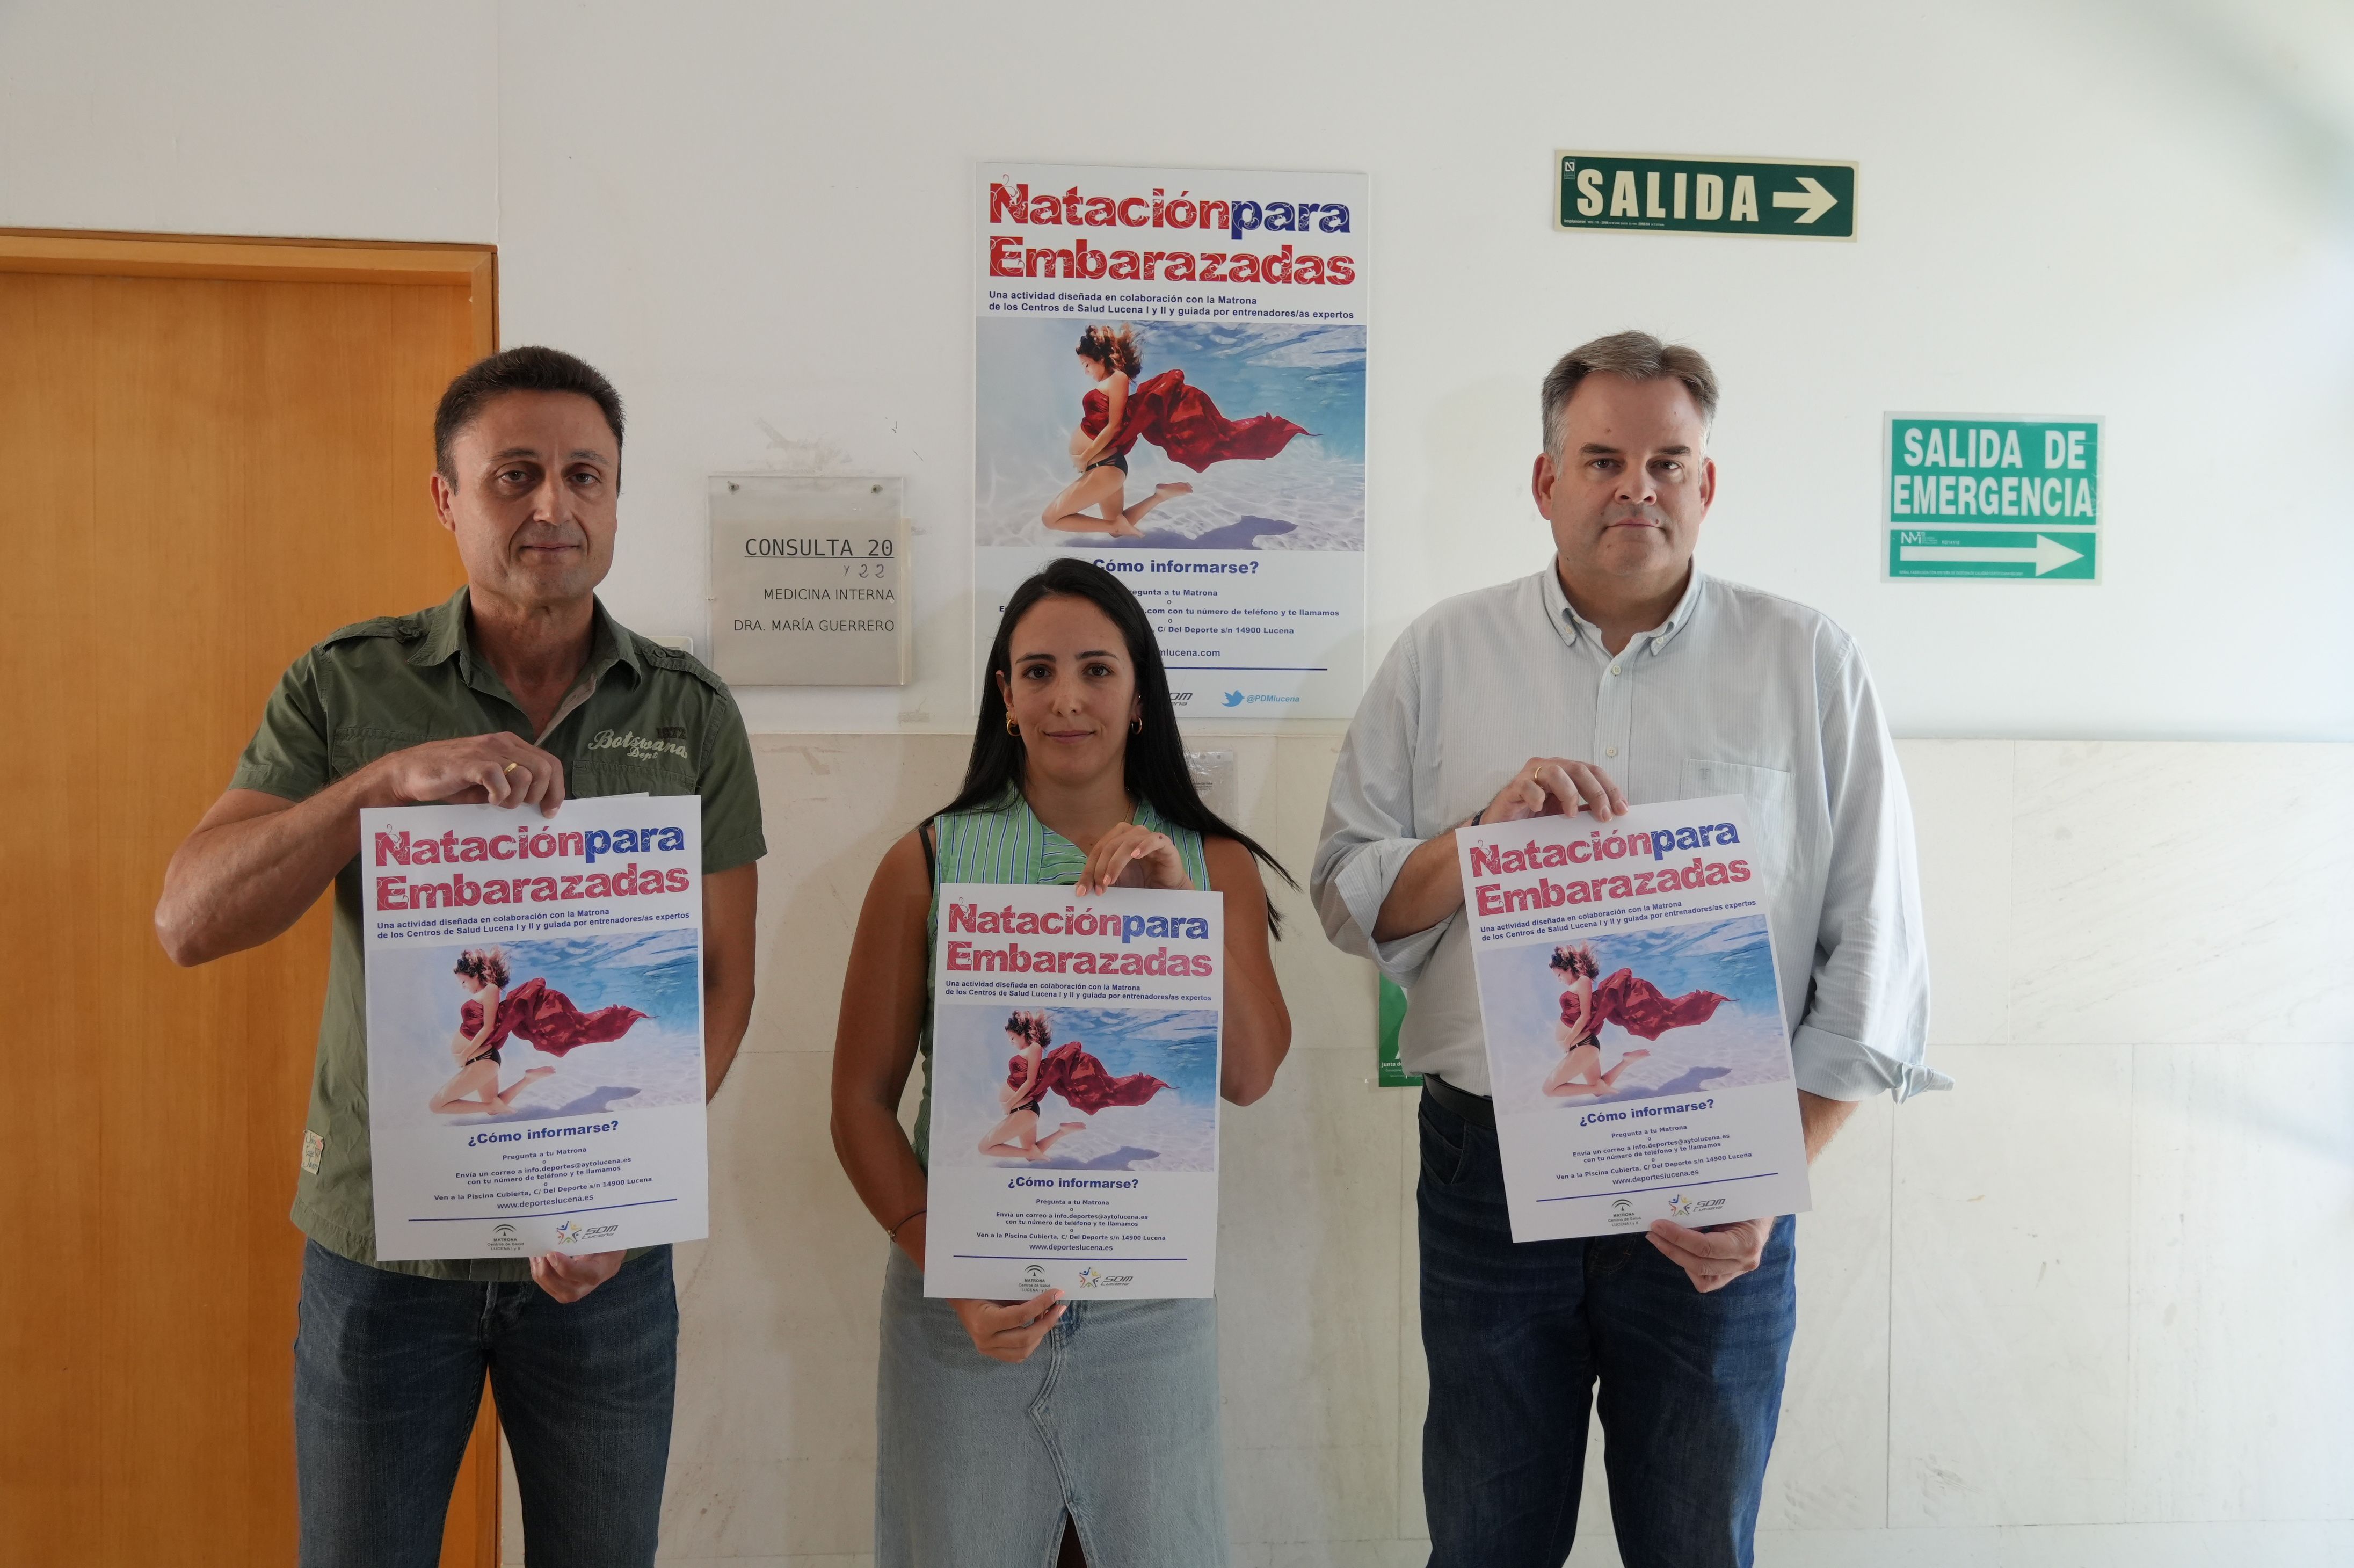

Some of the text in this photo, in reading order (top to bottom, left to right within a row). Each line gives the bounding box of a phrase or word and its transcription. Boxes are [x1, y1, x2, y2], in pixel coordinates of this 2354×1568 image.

[1577, 169, 1759, 222] SALIDA
[989, 236, 1356, 286] Embarazadas
[989, 290, 1008, 299] Una
[1011, 291, 1055, 300] actividad
[1058, 292, 1102, 301] diseñada
[1120, 293, 1182, 303] colaboración
[1207, 295, 1215, 304] la
[1218, 296, 1257, 305] Matrona
[989, 302, 1000, 310] de
[1004, 302, 1018, 311] los
[1021, 303, 1060, 311] Centros
[1063, 304, 1074, 312] de
[1077, 304, 1105, 313] Salud
[1108, 304, 1143, 314] Lucena
[1152, 307, 1158, 316] y
[1169, 308, 1175, 316] y
[1178, 307, 1210, 317] guiada
[1232, 308, 1310, 318] entrenadores/as
[1312, 310, 1354, 320] expertos
[1904, 427, 2086, 469] SALIDA DE
[1894, 475, 2094, 517] EMERGENCIA
[745, 539, 893, 556] CONSULTA 20
[1093, 559, 1259, 574] Cómo informarse?
[764, 589, 895, 600] MEDICINA INTERNA
[734, 618, 895, 631] DRA. MARÍA GUERRERO
[1185, 626, 1218, 635] Deporte
[1246, 695, 1299, 703] @PDMlucena
[588, 729, 688, 759] Botswana
[627, 747, 658, 761] Dept
[376, 863, 690, 911] Embarazadas
[1475, 858, 1752, 917] Embarazadas
[456, 926, 481, 934] Salud
[543, 920, 571, 930] guiada
[590, 915, 653, 925] entrenadores/as
[656, 912, 690, 921] expertos
[1496, 920, 1530, 931] actividad
[1532, 916, 1565, 926] diseñada
[1578, 908, 1626, 920] colaboración
[1652, 902, 1682, 910] Matrona
[947, 941, 1213, 977] Embarazadas
[1580, 1099, 1714, 1127] ¿Cómo informarse?
[468, 1120, 619, 1147] ¿Cómo informarse?
[1611, 1130, 1642, 1138] Pregunta
[1689, 1142, 1721, 1150] llamamos
[525, 1158, 631, 1173] info.deportes@aytolucena.es
[1008, 1177, 1139, 1189] ¿Cómo informarse?
[1612, 1170, 1699, 1185] www.deporteslucena.es
[497, 1195, 594, 1209] www.deporteslucena.es
[1029, 1244, 1113, 1252] www.deporteslucena.es
